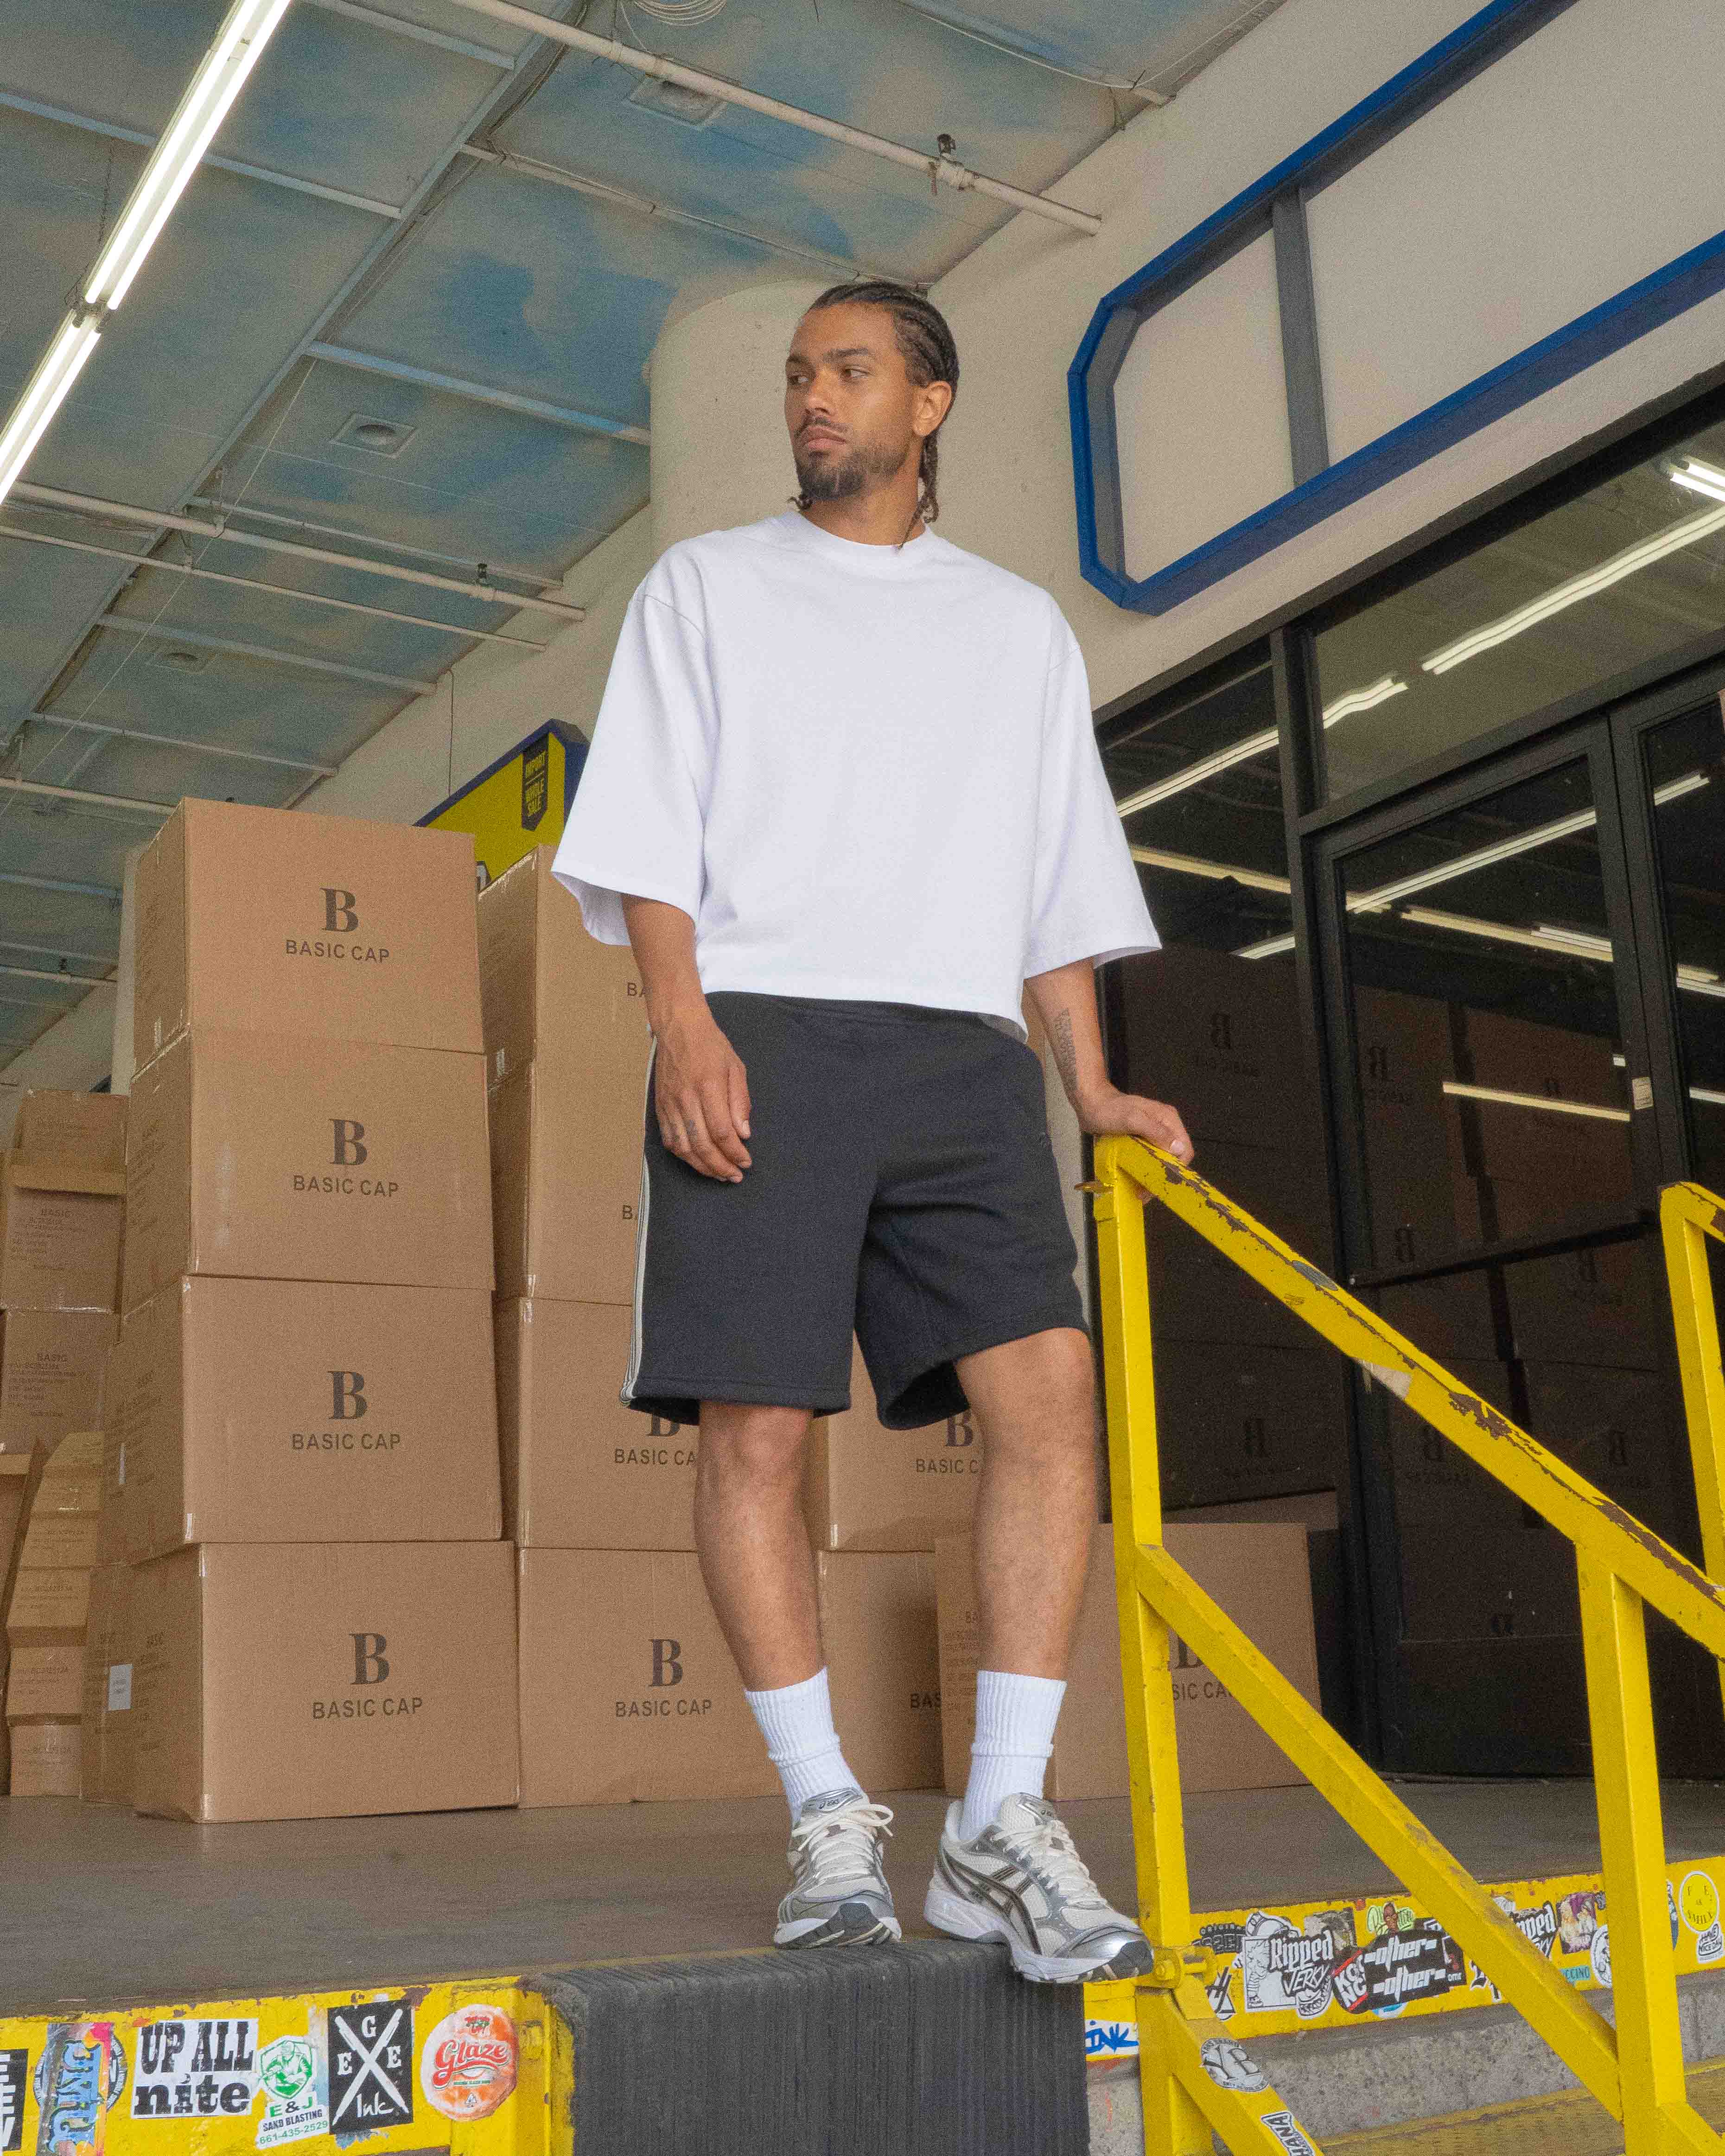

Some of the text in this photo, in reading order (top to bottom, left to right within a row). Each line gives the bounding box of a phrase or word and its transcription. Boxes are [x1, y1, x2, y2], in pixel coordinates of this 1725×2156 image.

[320, 887, 359, 932] B
[286, 939, 389, 963] BASIC CAP
[329, 1118, 368, 1165] B
[293, 1175, 399, 1197] BASIC CAP
[328, 1371, 368, 1419] B
[292, 1433, 401, 1450] BASIC CAP
[615, 1448, 696, 1465] BASIC CA
[916, 1458, 964, 1474] BASIC
[349, 1632, 390, 1685] B
[649, 1639, 683, 1687] B
[910, 1693, 942, 1709] BAS
[1204, 1681, 1229, 1698] CA
[312, 1697, 423, 1720] BASIC CAP
[615, 1699, 712, 1717] BASIC CAP
[361, 2016, 376, 2038] G
[140, 2022, 185, 2074] UP
[191, 2021, 253, 2072] ALL
[337, 2046, 401, 2075] E E
[433, 2039, 509, 2087] Glaze
[133, 2074, 250, 2116] nite
[270, 2096, 312, 2117] E & J
[356, 2093, 394, 2118] Ink
[263, 2109, 323, 2131] SAND BLASTING
